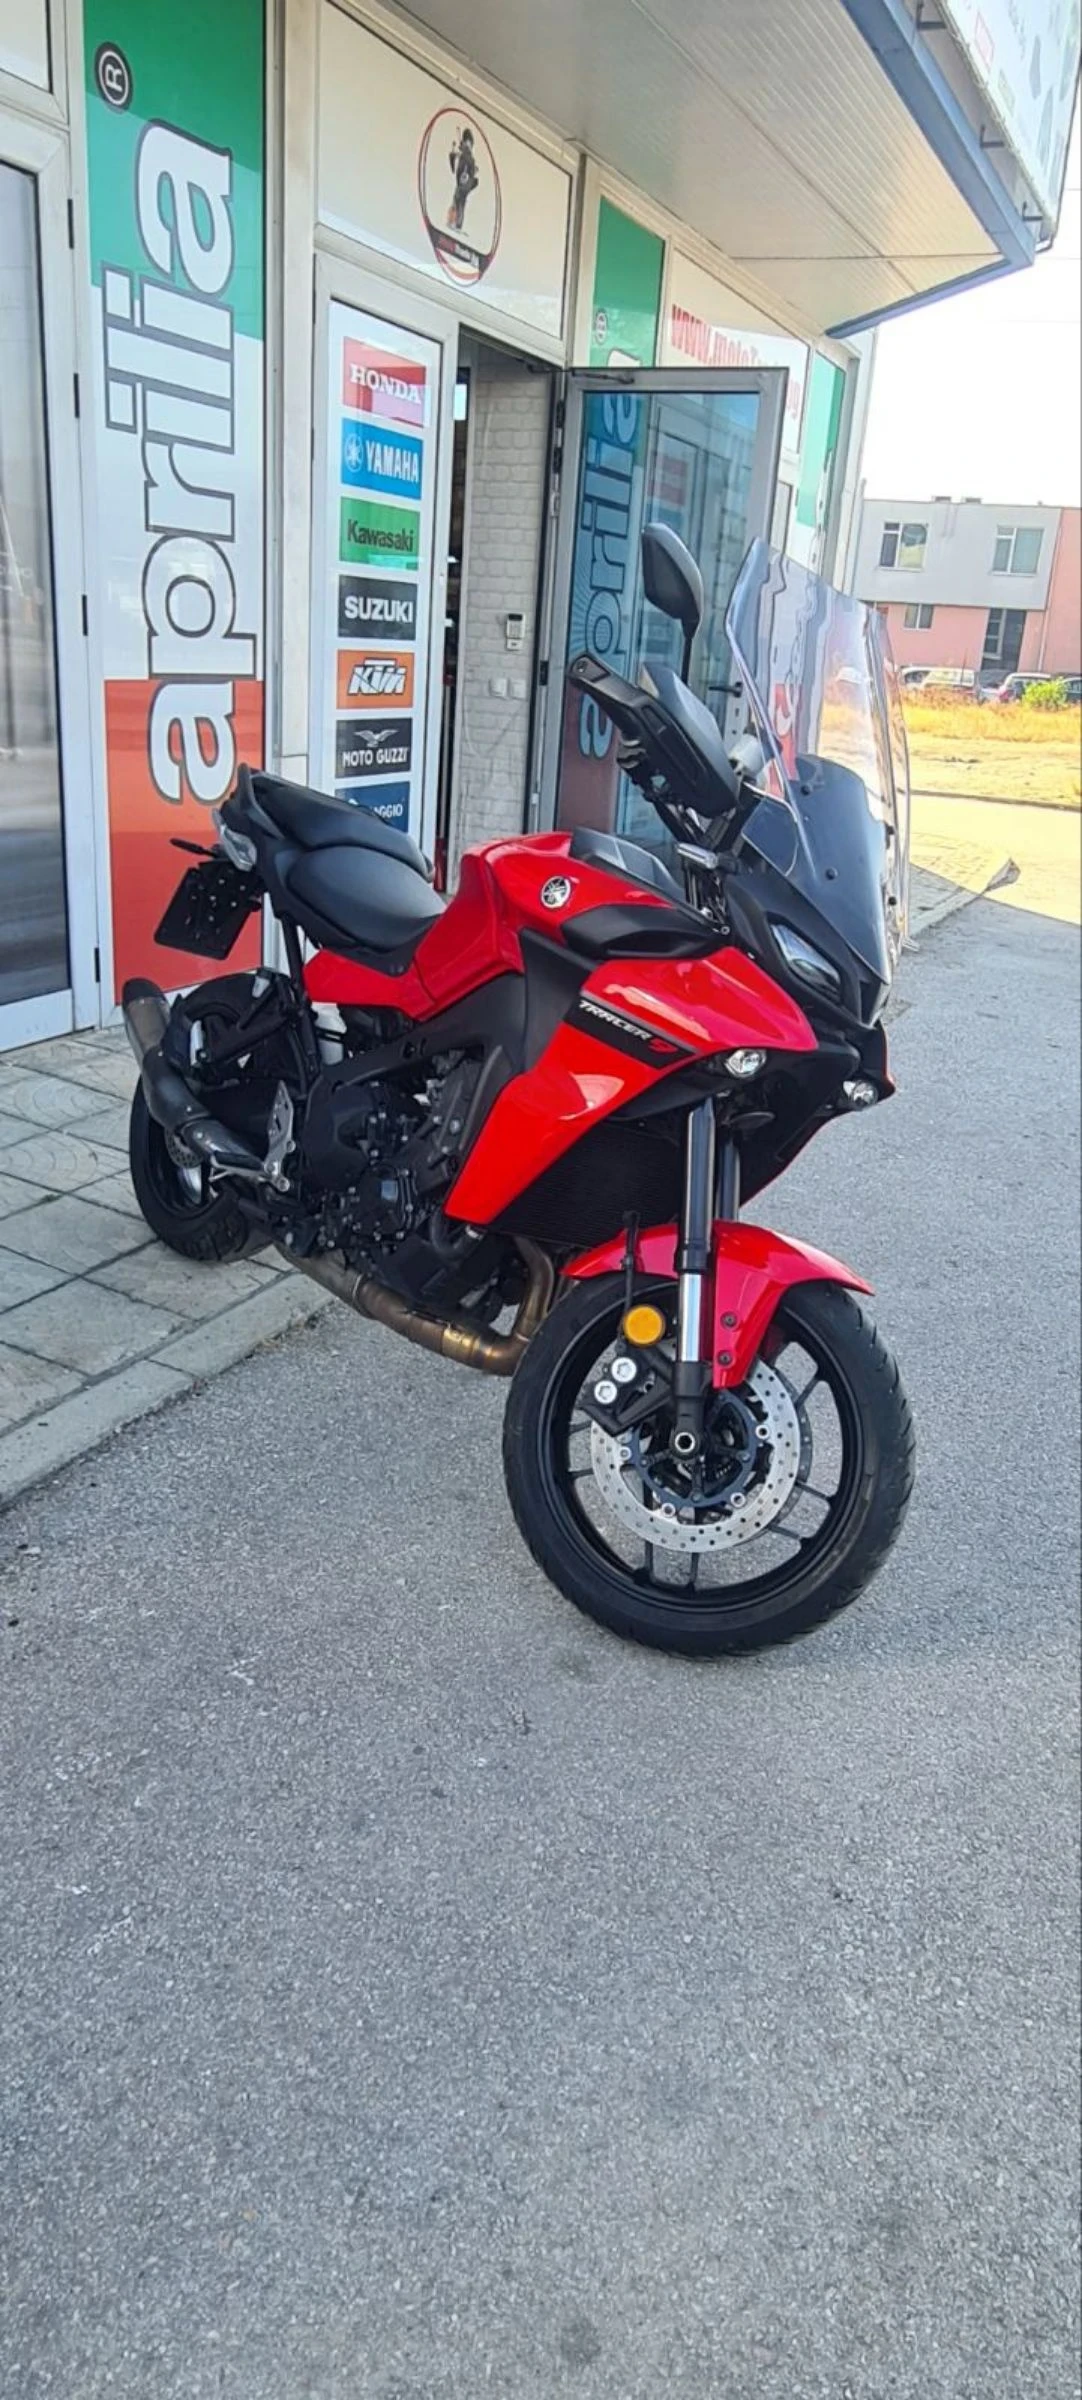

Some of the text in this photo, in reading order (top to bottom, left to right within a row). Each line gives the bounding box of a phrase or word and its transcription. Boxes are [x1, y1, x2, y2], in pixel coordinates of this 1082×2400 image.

[350, 364, 421, 404] HONDA
[101, 118, 257, 805] aprilia
[365, 441, 419, 483] YAMAHA
[347, 518, 414, 552] Kawasaki
[344, 595, 414, 623] SUZUKI
[347, 657, 407, 695] KTM
[342, 746, 409, 767] MOTO GUZZI
[579, 1000, 653, 1040] TRACER
